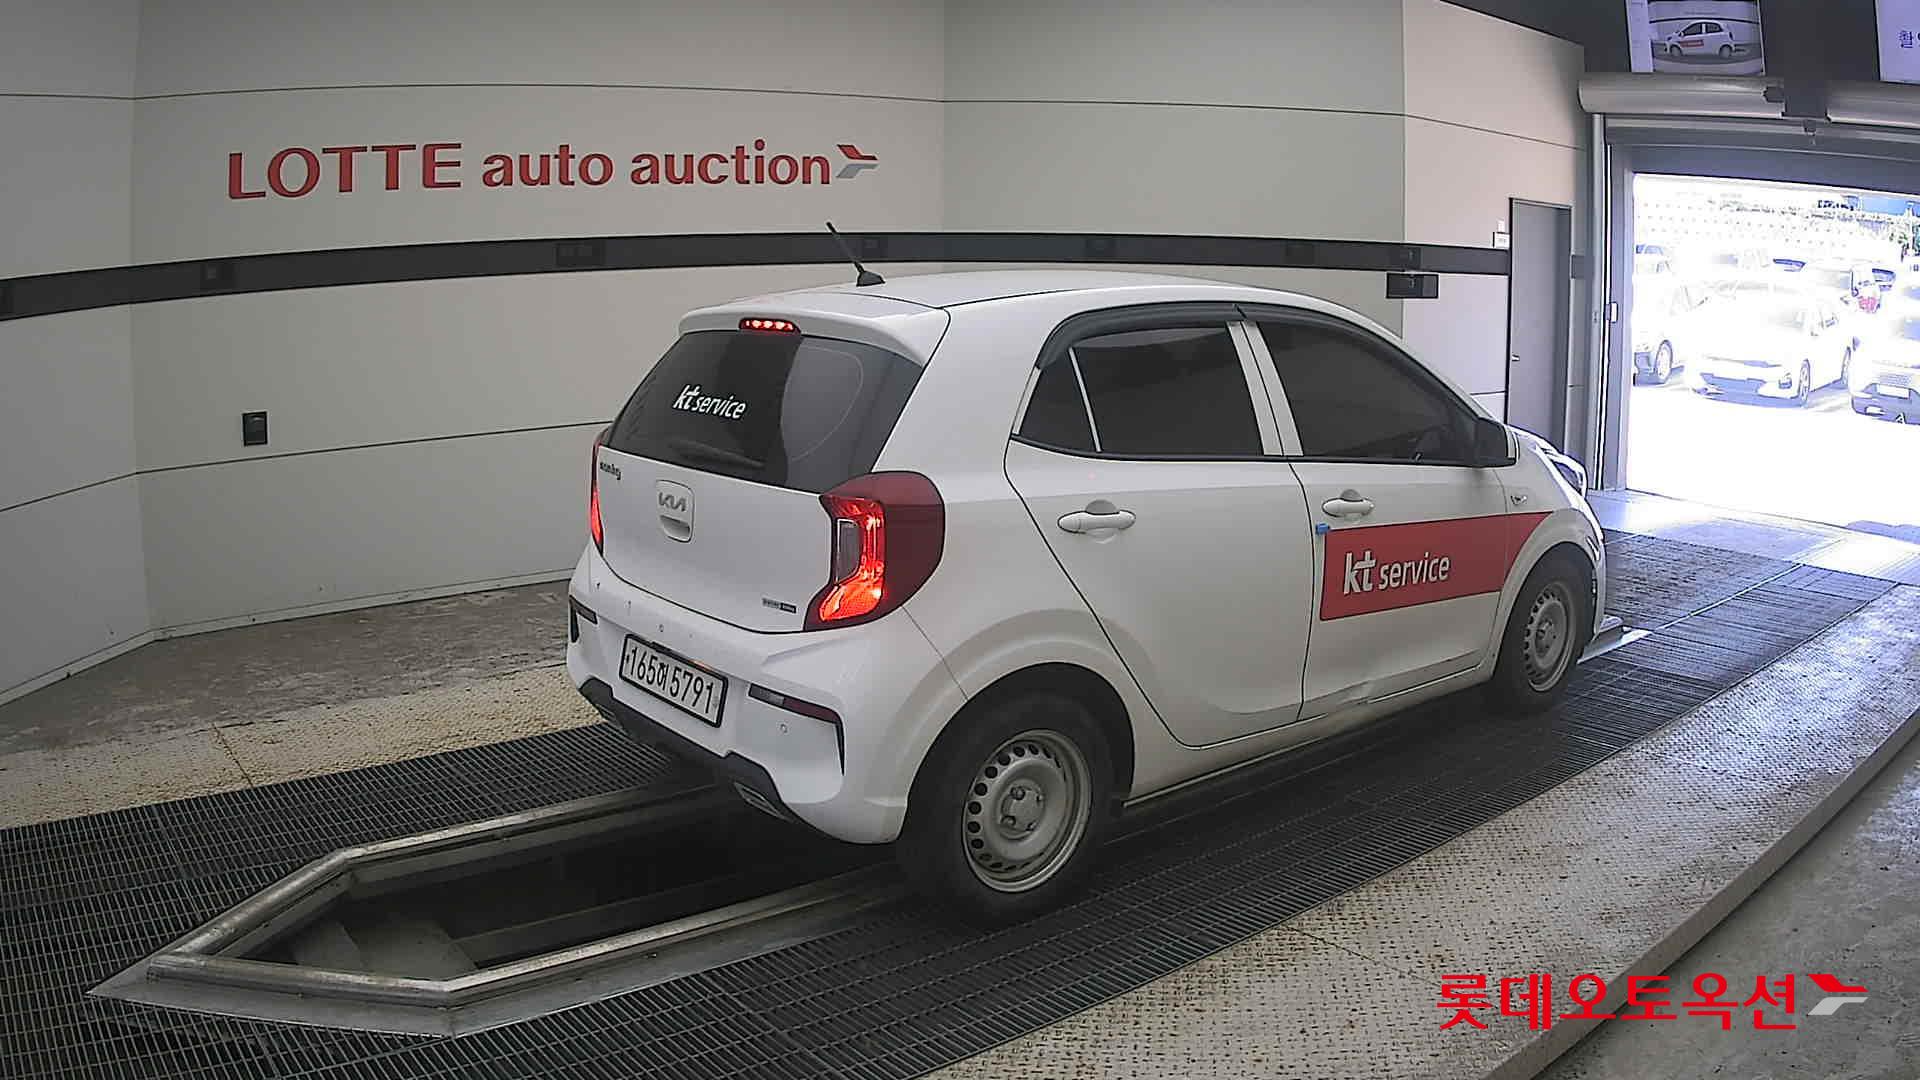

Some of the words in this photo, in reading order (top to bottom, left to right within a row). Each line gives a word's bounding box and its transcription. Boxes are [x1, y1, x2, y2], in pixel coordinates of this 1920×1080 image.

[228, 143, 462, 200] LOTTE
[482, 144, 614, 187] auto
[630, 138, 831, 186] auction
[672, 384, 700, 410] kt
[691, 395, 746, 419] service
[1343, 550, 1377, 595] kt
[1378, 551, 1450, 590] service
